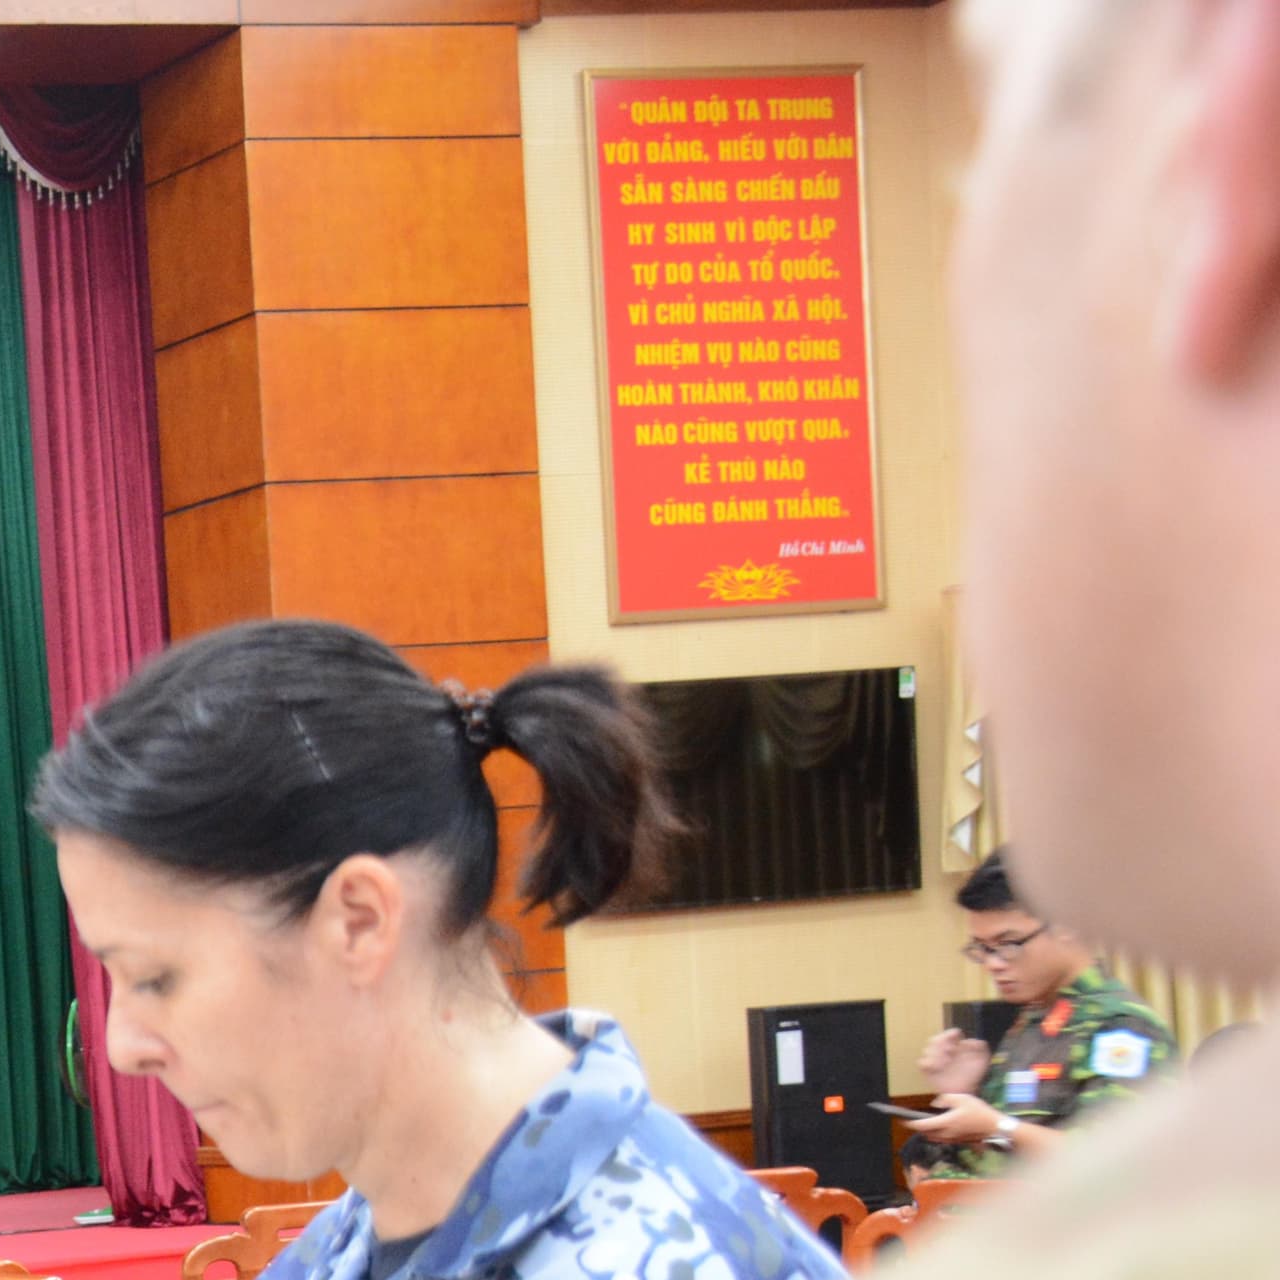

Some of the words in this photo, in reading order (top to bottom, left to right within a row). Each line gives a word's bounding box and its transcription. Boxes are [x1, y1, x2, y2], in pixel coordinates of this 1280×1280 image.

[693, 95, 729, 126] ĐỘI
[735, 99, 761, 121] TA
[767, 97, 834, 120] TRUNG
[603, 138, 640, 164] VỚI
[773, 133, 809, 160] VỚI
[670, 177, 728, 203] SÀNG
[736, 173, 796, 202] CHIẾN
[800, 171, 841, 200] ĐẤU
[628, 223, 655, 245] HY
[665, 222, 716, 244] SINH
[724, 217, 746, 243] VÌ
[752, 215, 793, 245] ĐỘC
[798, 214, 837, 244] LẬP
[632, 261, 659, 290] TỰ
[665, 262, 693, 284] DO
[699, 253, 741, 283] CỦA
[748, 250, 774, 282] TỔ
[628, 299, 648, 325] VÌ
[655, 294, 696, 325] CHỦ
[772, 294, 800, 321] XÃ
[635, 339, 700, 369] NHIỆM
[706, 342, 733, 368] VỤ
[738, 337, 780, 363] NÀO
[785, 335, 841, 362] CŨNG
[617, 380, 673, 406] HOÀN
[679, 378, 752, 404] THÀNH,
[758, 376, 799, 402] KHÓ
[635, 420, 678, 446] NÀO
[683, 417, 738, 444] CŨNG
[684, 454, 711, 484] KẺ
[717, 456, 757, 483] THÙ
[763, 455, 805, 480] NÀO
[650, 498, 706, 526] CŨNG
[712, 496, 768, 523] ĐÁNH
[828, 539, 865, 554] Minh
